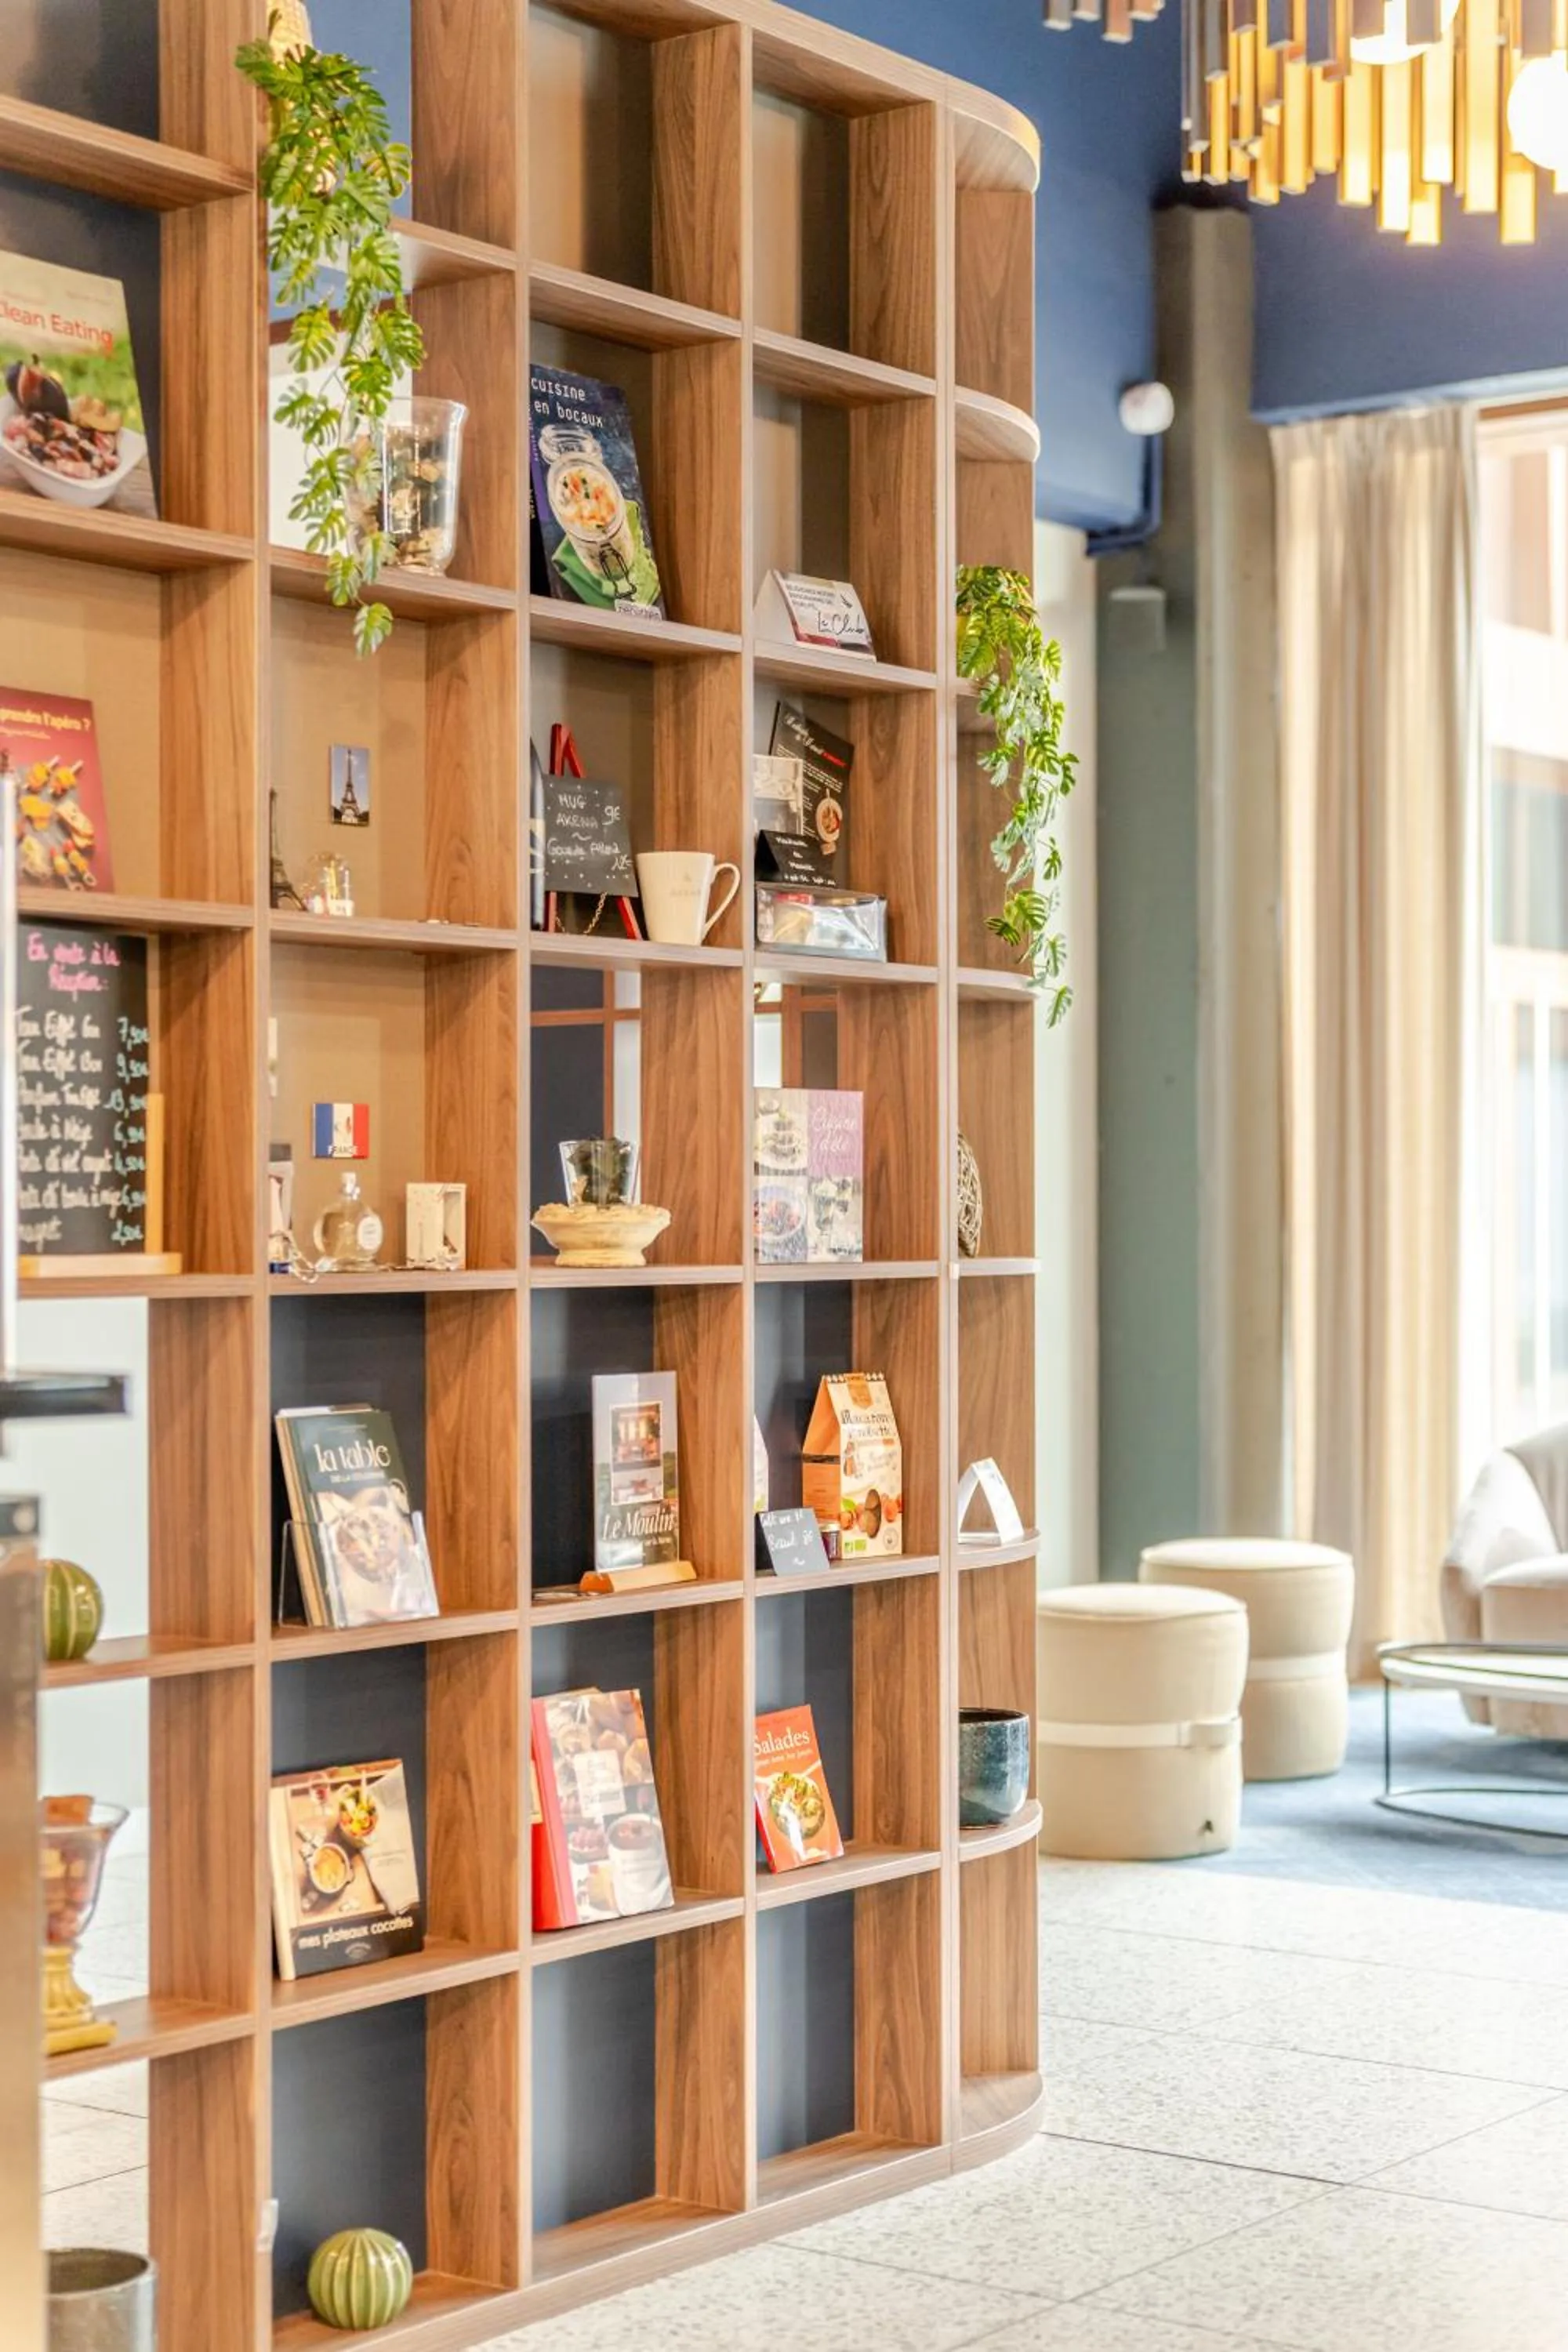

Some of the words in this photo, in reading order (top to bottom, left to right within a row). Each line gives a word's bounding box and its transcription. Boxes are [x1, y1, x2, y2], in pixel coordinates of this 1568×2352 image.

[51, 314, 113, 354] Eating
[531, 377, 586, 401] cuisine
[534, 401, 550, 416] en
[556, 401, 603, 428] bocaux
[558, 793, 586, 810] MUG
[314, 1443, 338, 1473] la
[338, 1439, 391, 1470] table
[602, 1514, 622, 1541] Le
[622, 1505, 675, 1537] Moulin
[753, 1726, 811, 1756] Salades
